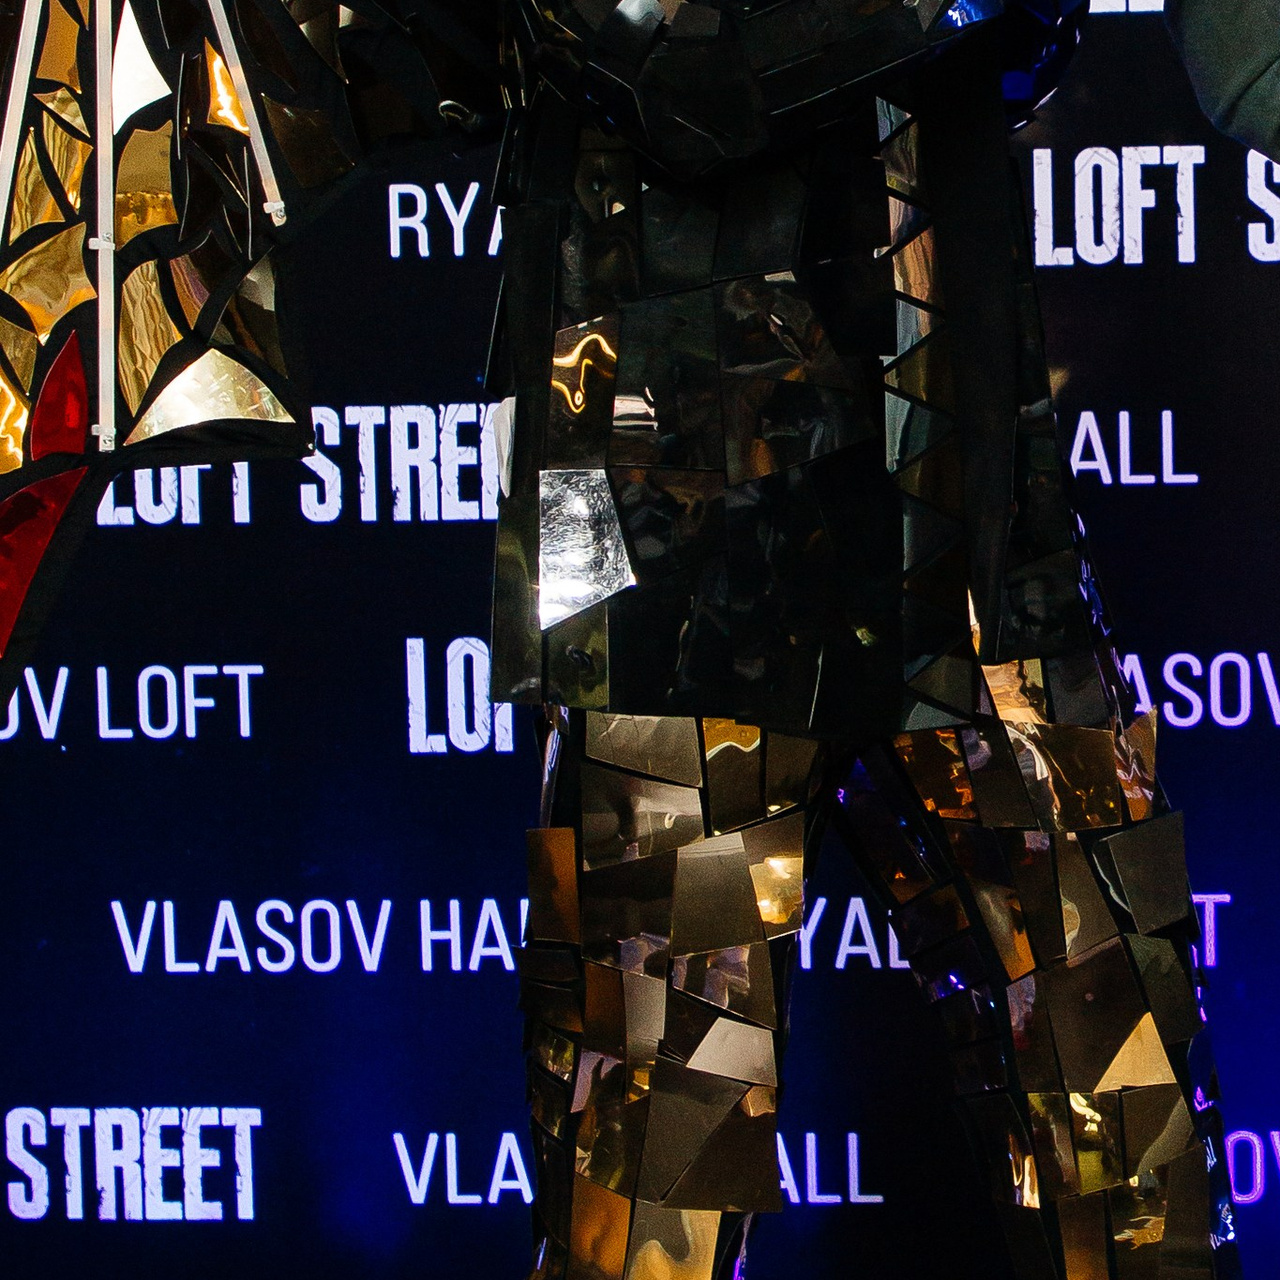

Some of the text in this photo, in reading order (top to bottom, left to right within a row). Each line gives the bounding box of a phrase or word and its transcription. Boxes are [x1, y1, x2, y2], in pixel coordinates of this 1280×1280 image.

[1032, 144, 1206, 267] LOFT
[301, 403, 501, 523] STREE
[1070, 409, 1199, 485] ALL
[96, 664, 264, 739] LOFT
[110, 899, 392, 973] VLASOV
[5, 1106, 262, 1221] STREET
